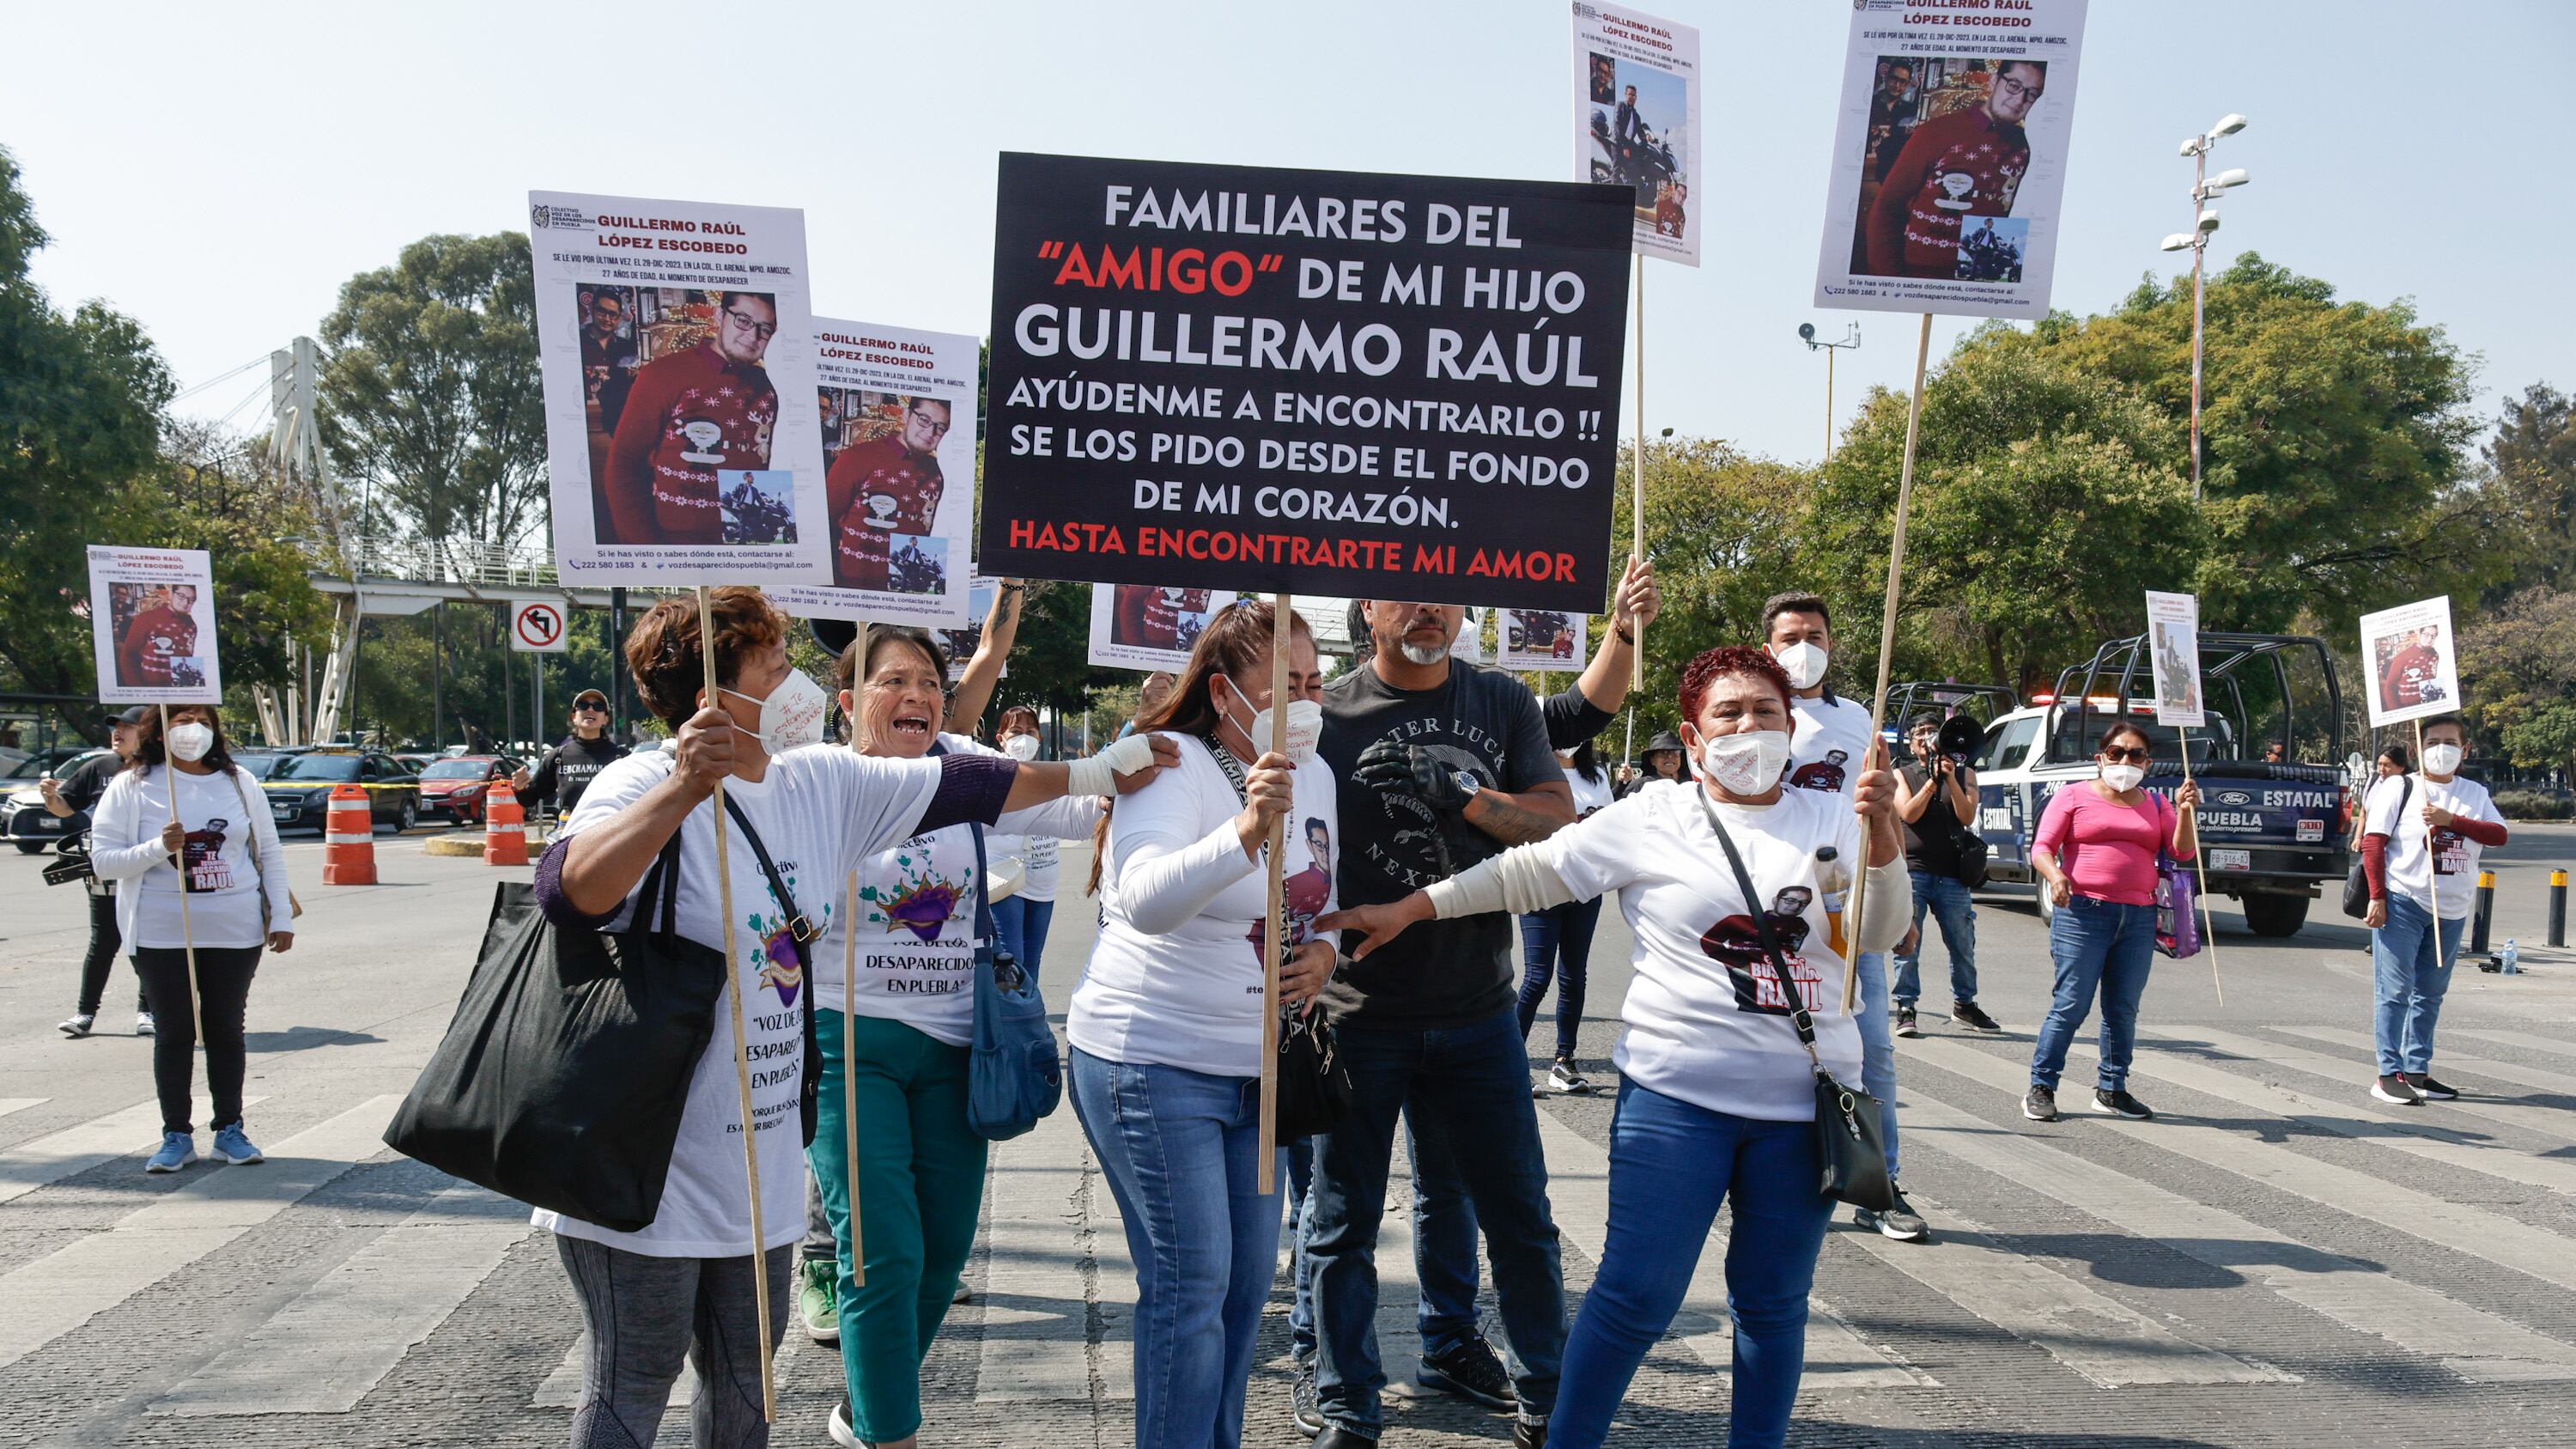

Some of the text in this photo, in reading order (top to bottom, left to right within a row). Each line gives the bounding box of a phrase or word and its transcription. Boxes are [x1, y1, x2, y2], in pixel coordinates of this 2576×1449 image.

[1906, 0, 1990, 9] GUILLERMO
[1603, 13, 1672, 40] GUILLERMO RAÚL
[1904, 12, 2032, 27] LÓPEZ ESCOBEDO
[1603, 25, 1629, 40] LÓPEZ
[1631, 33, 1673, 52] ESCOBEDO
[598, 215, 746, 236] GUILLERMO RAÚL
[1104, 185, 1522, 249] FAMILIARES DEL
[598, 233, 748, 255] LÓPEZ ESCOBEDO
[553, 253, 561, 262] SE
[570, 254, 582, 263] VIO
[582, 255, 595, 264] POR
[596, 255, 619, 265] ÚLTIMA
[619, 258, 632, 266] VEZ
[613, 269, 629, 279] AÑOS
[667, 273, 698, 283] MOMENTO
[698, 275, 707, 283] DE
[708, 276, 750, 286] DESAPARECER
[1297, 258, 1365, 302] DE
[1379, 261, 1444, 307] MI
[1463, 266, 1586, 314] HIJO
[1860, 289, 1877, 297] 1683
[1904, 291, 2030, 306] vozdesaparecidospuebla@gmail.com
[821, 332, 934, 355] GUILLERMO RAÚL
[1013, 303, 1599, 388] GUILLERMO RAÚL
[820, 347, 935, 369] LÓPEZ ESCOBEDO
[1005, 370, 1602, 442] AYÚDENME A ENCONTRARLO !!
[1010, 423, 1589, 490] SE LOS PIDO DESDE EL FONDO
[1133, 478, 1460, 529] DE MI CORAZÓN.
[716, 551, 736, 559] está,
[785, 550, 795, 558] al:
[1009, 519, 1577, 583] HASTA ENCONTRARTE MI AMOR
[667, 561, 813, 570] vozdesaparecidospuebla@gmail.com
[1451, 718, 1506, 772] LUCK
[558, 764, 604, 775] LENCHAMAN
[2263, 789, 2334, 808] ESTATAL
[1983, 807, 2013, 831] ESTATAL
[2196, 811, 2263, 826] PUEBLA
[2205, 824, 2233, 832] gobierno
[2233, 825, 2263, 834] presente
[2452, 839, 2463, 849] TE
[1365, 842, 1441, 887] NEXT
[866, 954, 975, 971] DESAPARECIDO
[887, 978, 908, 993] EN
[751, 1072, 769, 1089] EN
[726, 1123, 737, 1134] ES
